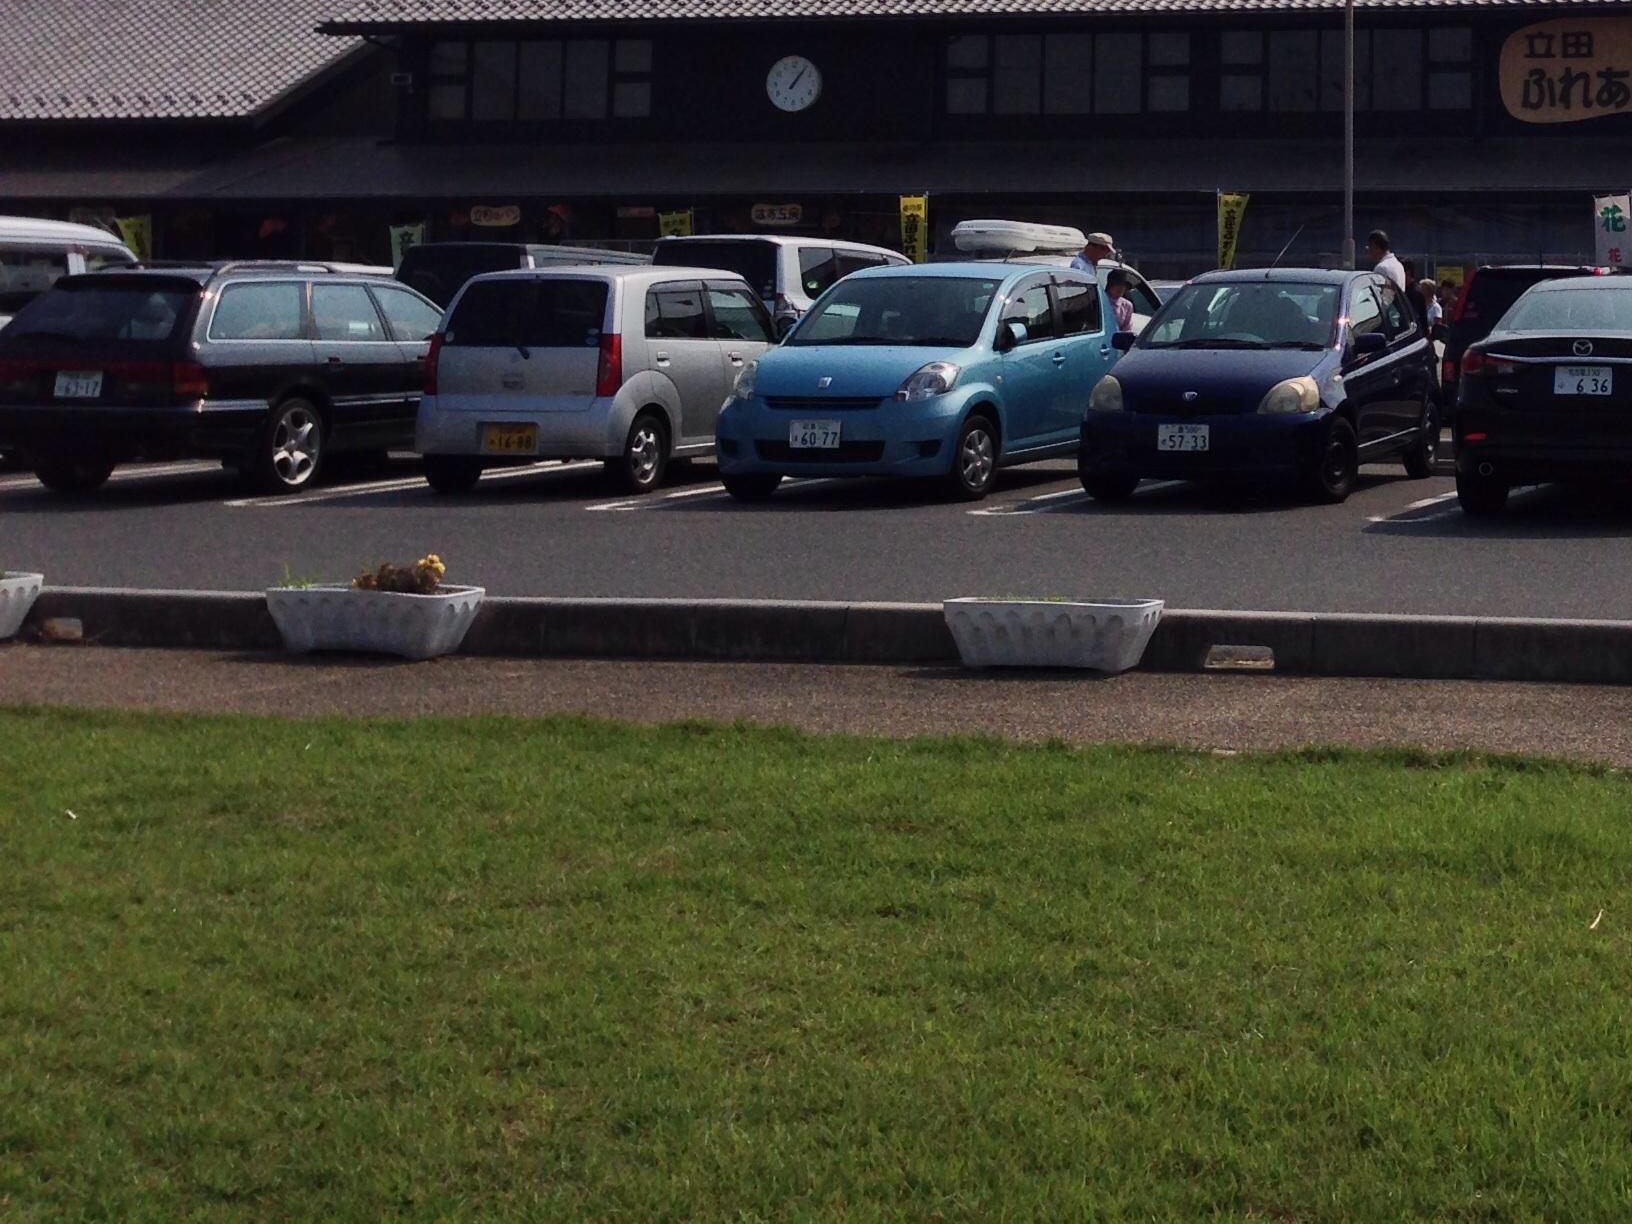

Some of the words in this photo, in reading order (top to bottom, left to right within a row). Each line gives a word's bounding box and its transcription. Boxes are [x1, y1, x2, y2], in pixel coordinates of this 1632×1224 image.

[1524, 31, 1594, 59] 立田
[1600, 204, 1626, 233] 花
[1168, 434, 1208, 450] 57-33
